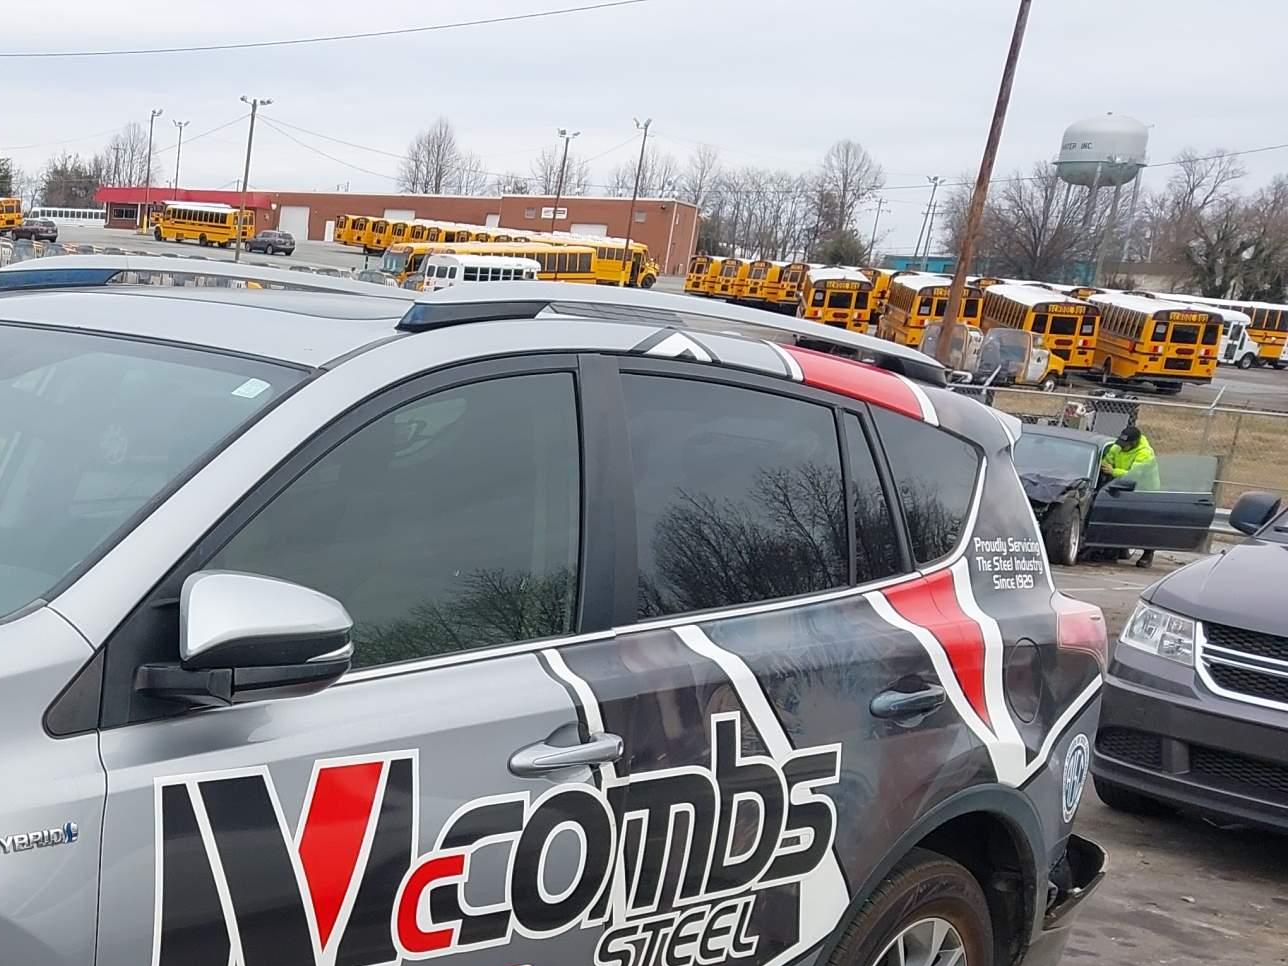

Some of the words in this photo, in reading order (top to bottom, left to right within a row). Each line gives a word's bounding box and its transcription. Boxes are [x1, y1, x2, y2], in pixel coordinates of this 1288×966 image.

[973, 537, 1007, 555] Proudly
[1007, 537, 1040, 556] Servicing
[976, 556, 992, 571] The
[993, 556, 1013, 571] Steel
[1014, 556, 1043, 574] Industry
[993, 574, 1016, 589] Since
[1015, 574, 1034, 589] 1929
